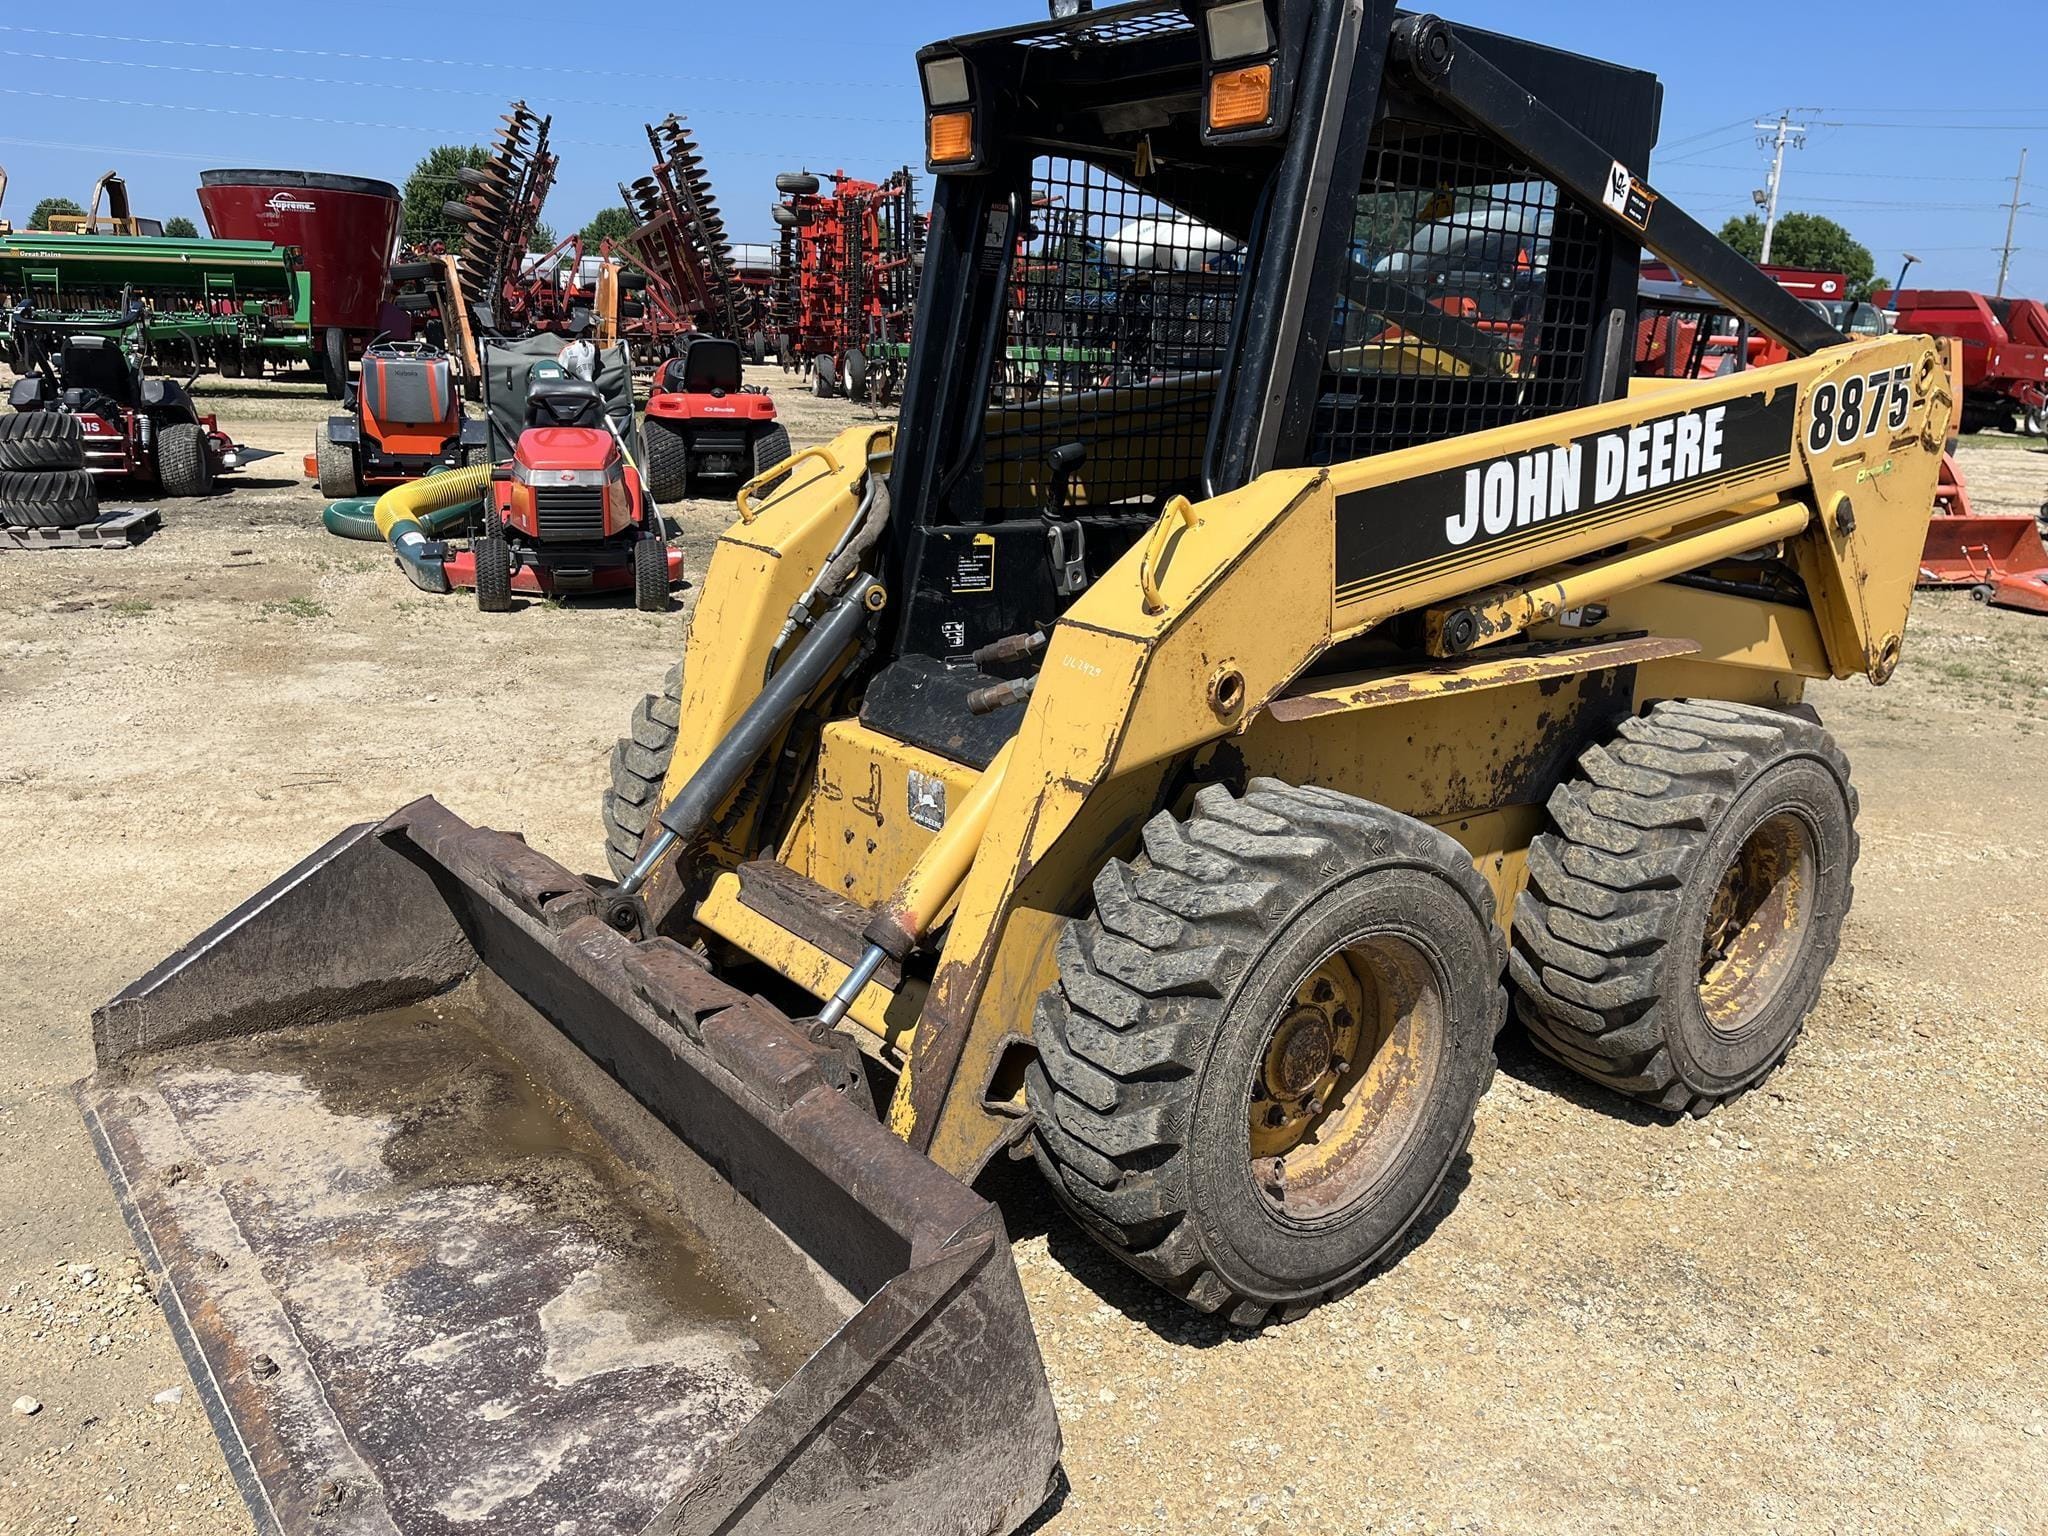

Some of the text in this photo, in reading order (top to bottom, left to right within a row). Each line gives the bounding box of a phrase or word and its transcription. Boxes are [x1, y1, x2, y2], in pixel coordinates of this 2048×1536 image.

[265, 199, 316, 212] Supreme
[1808, 363, 1913, 455] 8875
[1446, 406, 1726, 545] JOHN DEERE
[924, 816, 942, 829] DEERE
